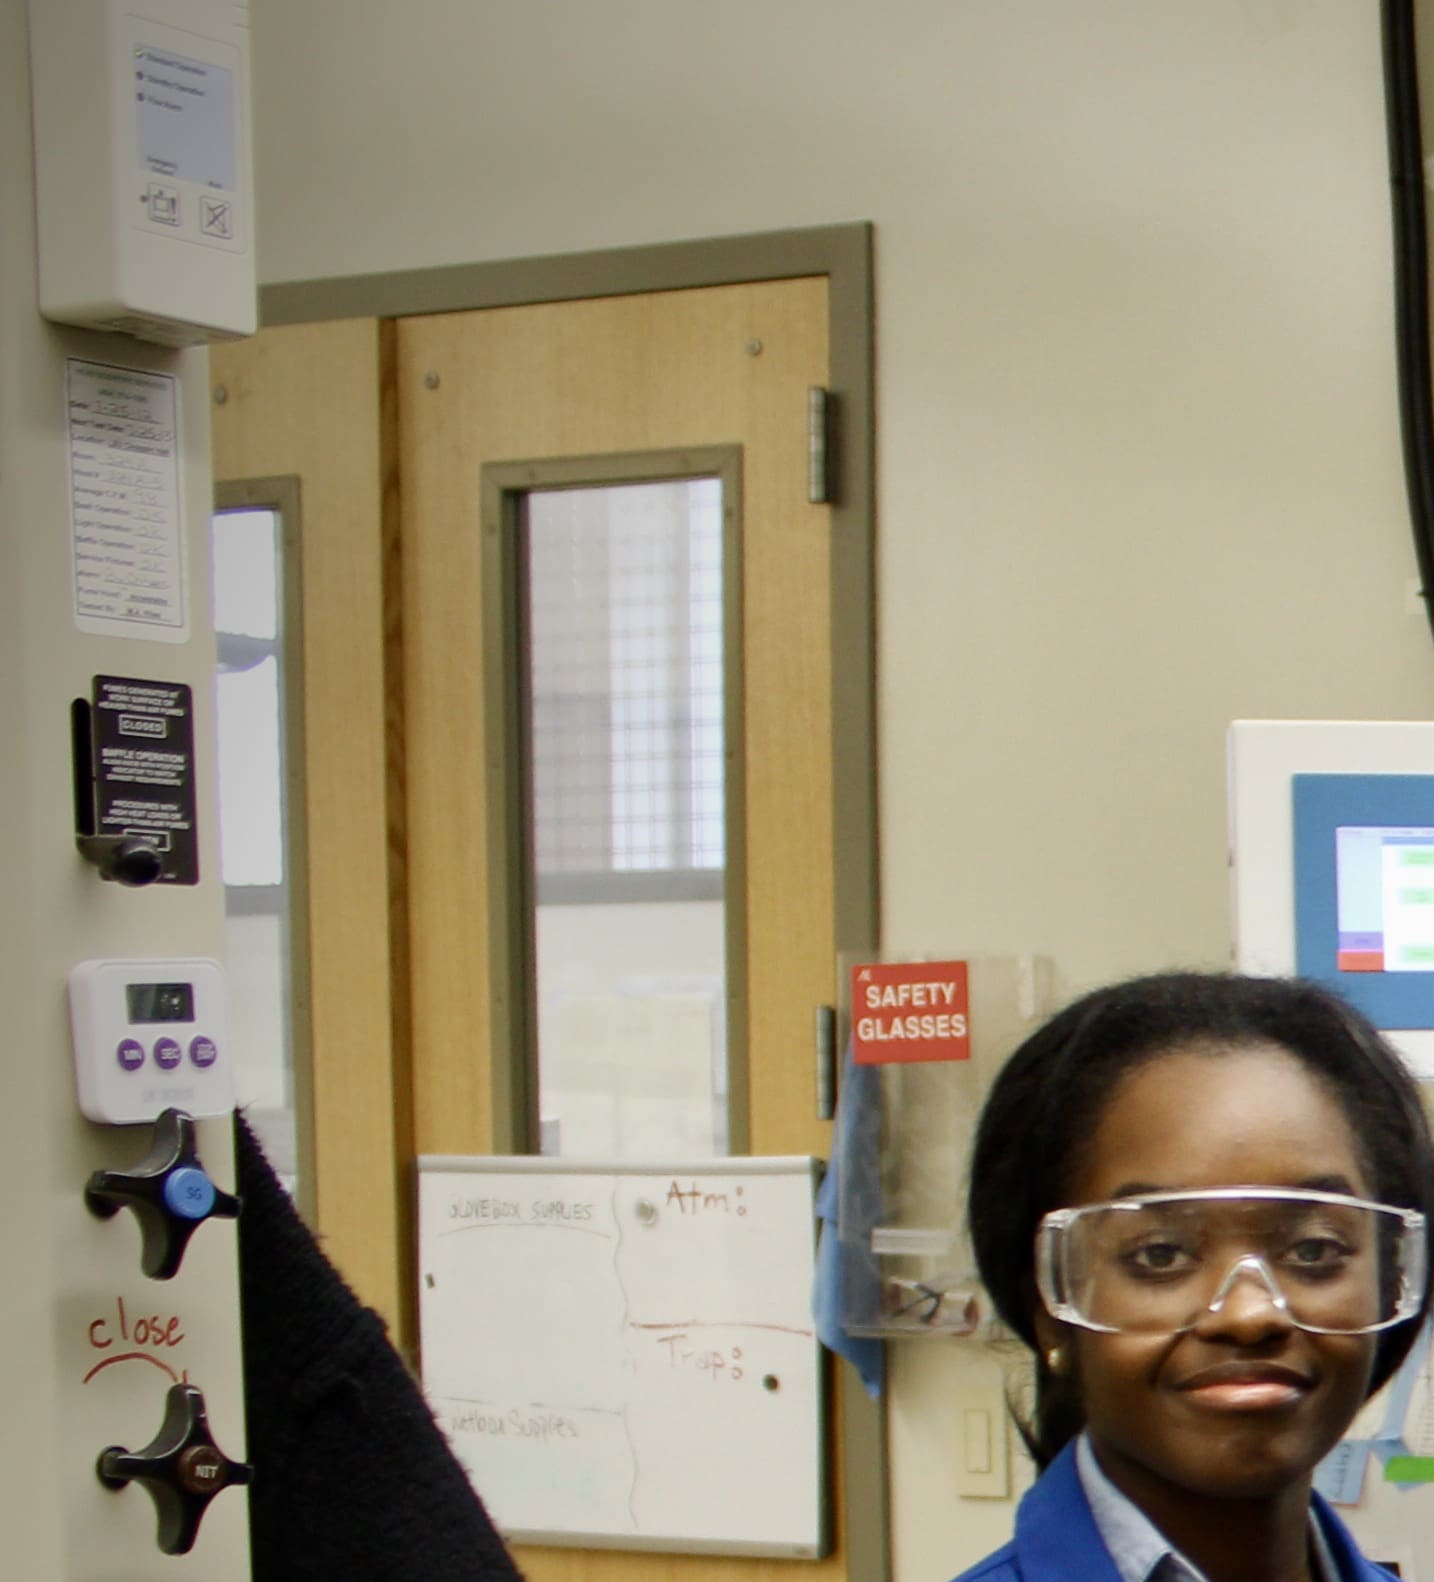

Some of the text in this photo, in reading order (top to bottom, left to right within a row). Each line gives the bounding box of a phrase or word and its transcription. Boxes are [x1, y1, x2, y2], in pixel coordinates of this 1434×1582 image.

[123, 720, 162, 732] CLOSED
[135, 751, 185, 763] OPERATION
[865, 982, 956, 1009] SAFETY
[857, 1013, 967, 1042] GLASSES
[160, 1047, 181, 1060] SEC
[88, 1295, 186, 1350] close
